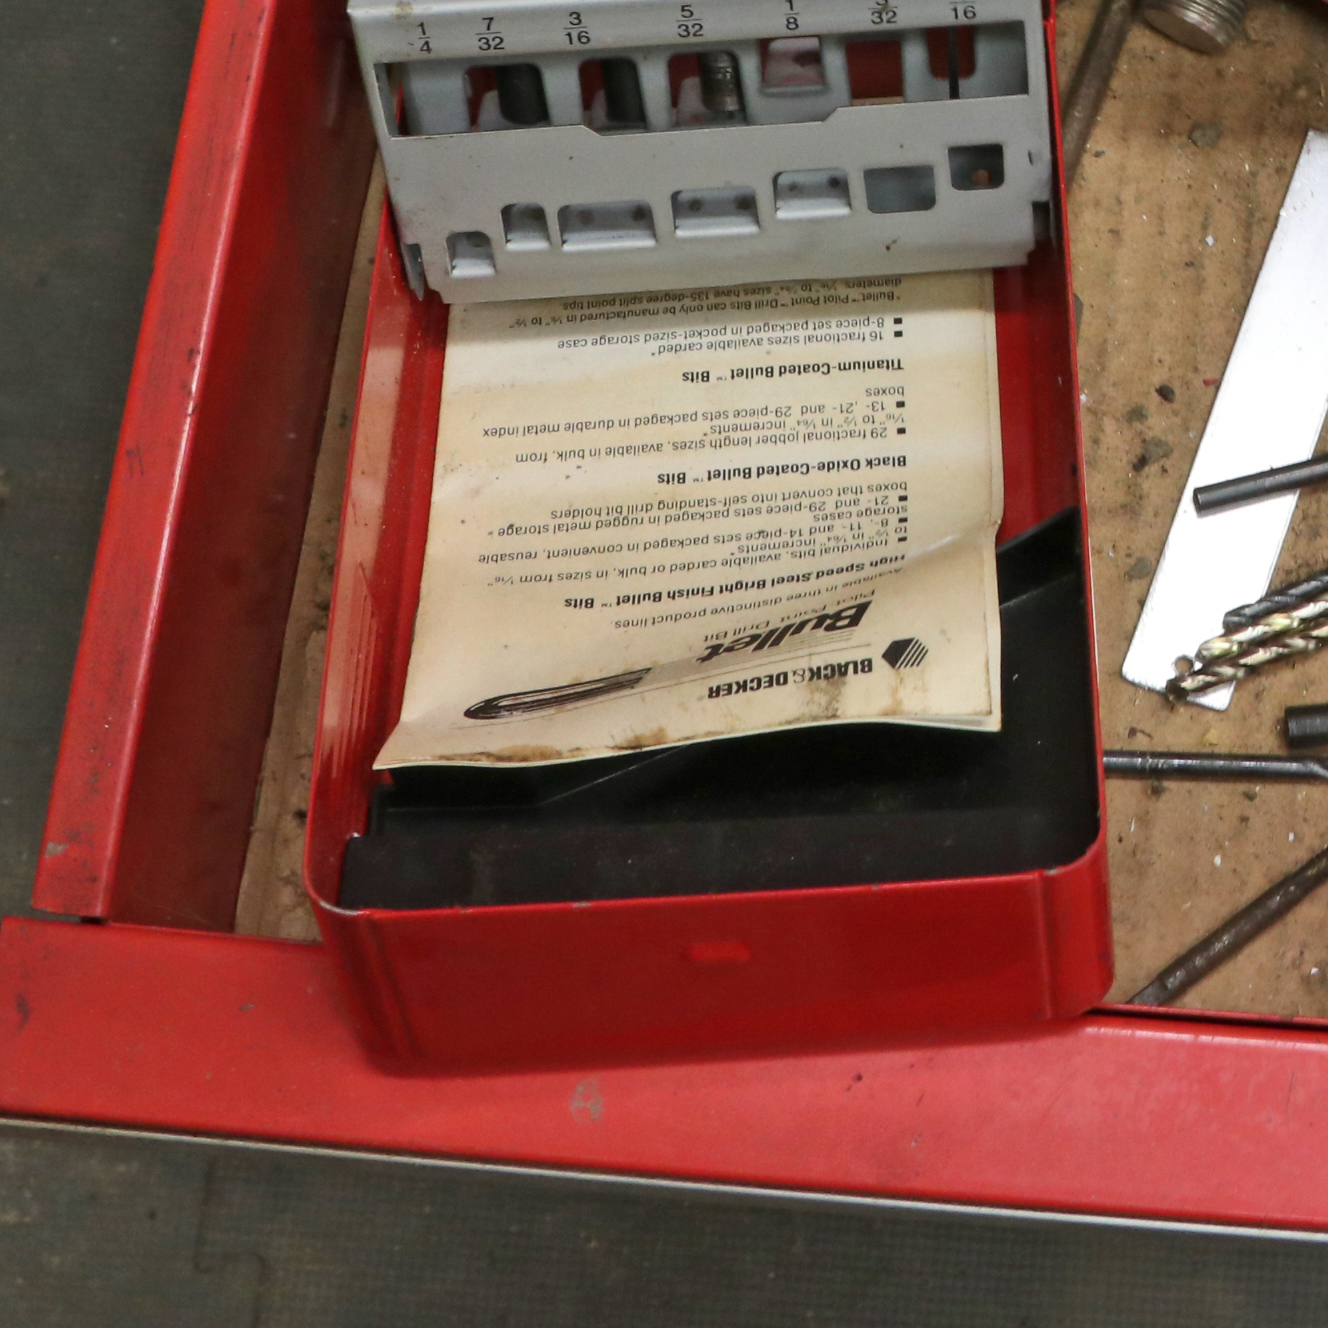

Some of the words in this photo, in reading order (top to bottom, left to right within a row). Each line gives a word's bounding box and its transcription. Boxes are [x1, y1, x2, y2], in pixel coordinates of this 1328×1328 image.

[645, 290, 709, 304] 135-degree
[713, 288, 740, 301] have
[743, 286, 772, 298] sizes
[823, 293, 849, 305] Pilot
[586, 298, 616, 310] point
[619, 294, 643, 308] split
[679, 302, 704, 314] only
[706, 302, 727, 313] can
[729, 300, 751, 311] Bits
[754, 298, 778, 309] Drill
[579, 307, 659, 324] manufactured
[662, 306, 675, 317] be
[812, 320, 832, 332] set
[835, 316, 885, 329] 8-piece
[644, 325, 727, 344] pocket-sized
[746, 321, 808, 339] packaged
[869, 330, 884, 341] 16
[557, 338, 588, 350] case
[590, 333, 640, 348] storage
[706, 336, 763, 351] available
[766, 334, 800, 346] sizes
[804, 331, 866, 346] fractional
[778, 358, 904, 378] Titanium-Coated
[682, 370, 710, 383] Bits
[864, 386, 905, 398] boxes
[634, 411, 698, 428] packaged
[701, 410, 729, 423] sets
[482, 426, 519, 439] index
[522, 422, 560, 436] metal
[564, 418, 615, 434] durable
[870, 426, 887, 438] 29
[709, 435, 752, 450] length
[755, 430, 800, 446] jobber
[802, 428, 866, 444] fractional
[604, 442, 663, 457] available
[667, 439, 706, 451] sizes,
[515, 452, 548, 464] from
[552, 448, 585, 462] bulk,
[756, 458, 861, 479] Oxide-Coated
[864, 455, 907, 470] Black
[656, 472, 687, 485] Bits
[781, 487, 833, 502] convert
[836, 485, 863, 498] that
[866, 481, 908, 496] boxes
[657, 494, 748, 512] self-standing
[751, 492, 777, 506] into
[550, 506, 602, 521] holders
[605, 504, 623, 517] bit
[626, 502, 653, 515] drill
[664, 506, 730, 525] packaged
[734, 506, 762, 518] sets
[856, 504, 908, 521] storage
[595, 514, 644, 531] rugged
[812, 510, 852, 523] cases
[497, 523, 549, 538] storage
[552, 521, 591, 535] metal
[745, 527, 804, 543] 14-piece
[809, 524, 834, 537] and
[643, 536, 709, 552] packaged
[713, 532, 742, 545] sets
[542, 542, 623, 560] convenient,
[820, 538, 887, 556] Individual
[477, 550, 538, 564] reusable
[721, 552, 781, 567] available
[869, 554, 905, 568] High
[612, 566, 647, 578] bulk,
[650, 564, 666, 574] or
[670, 560, 717, 577] carded
[815, 562, 865, 579] Speed
[519, 573, 553, 584] from
[557, 570, 592, 582] sizes
[771, 571, 811, 586] Steel
[842, 566, 903, 589] Available
[718, 578, 766, 594] Bright
[666, 586, 714, 601] Finish
[786, 588, 821, 602] three
[836, 588, 876, 606] Pilot
[564, 598, 594, 610] Bits
[710, 596, 782, 616] distinctive
[651, 608, 706, 626] product
[780, 604, 827, 622] Point
[610, 618, 648, 629] lines.
[732, 620, 770, 635] Drill
[695, 600, 873, 664] Bullet
[702, 630, 728, 642] Bit
